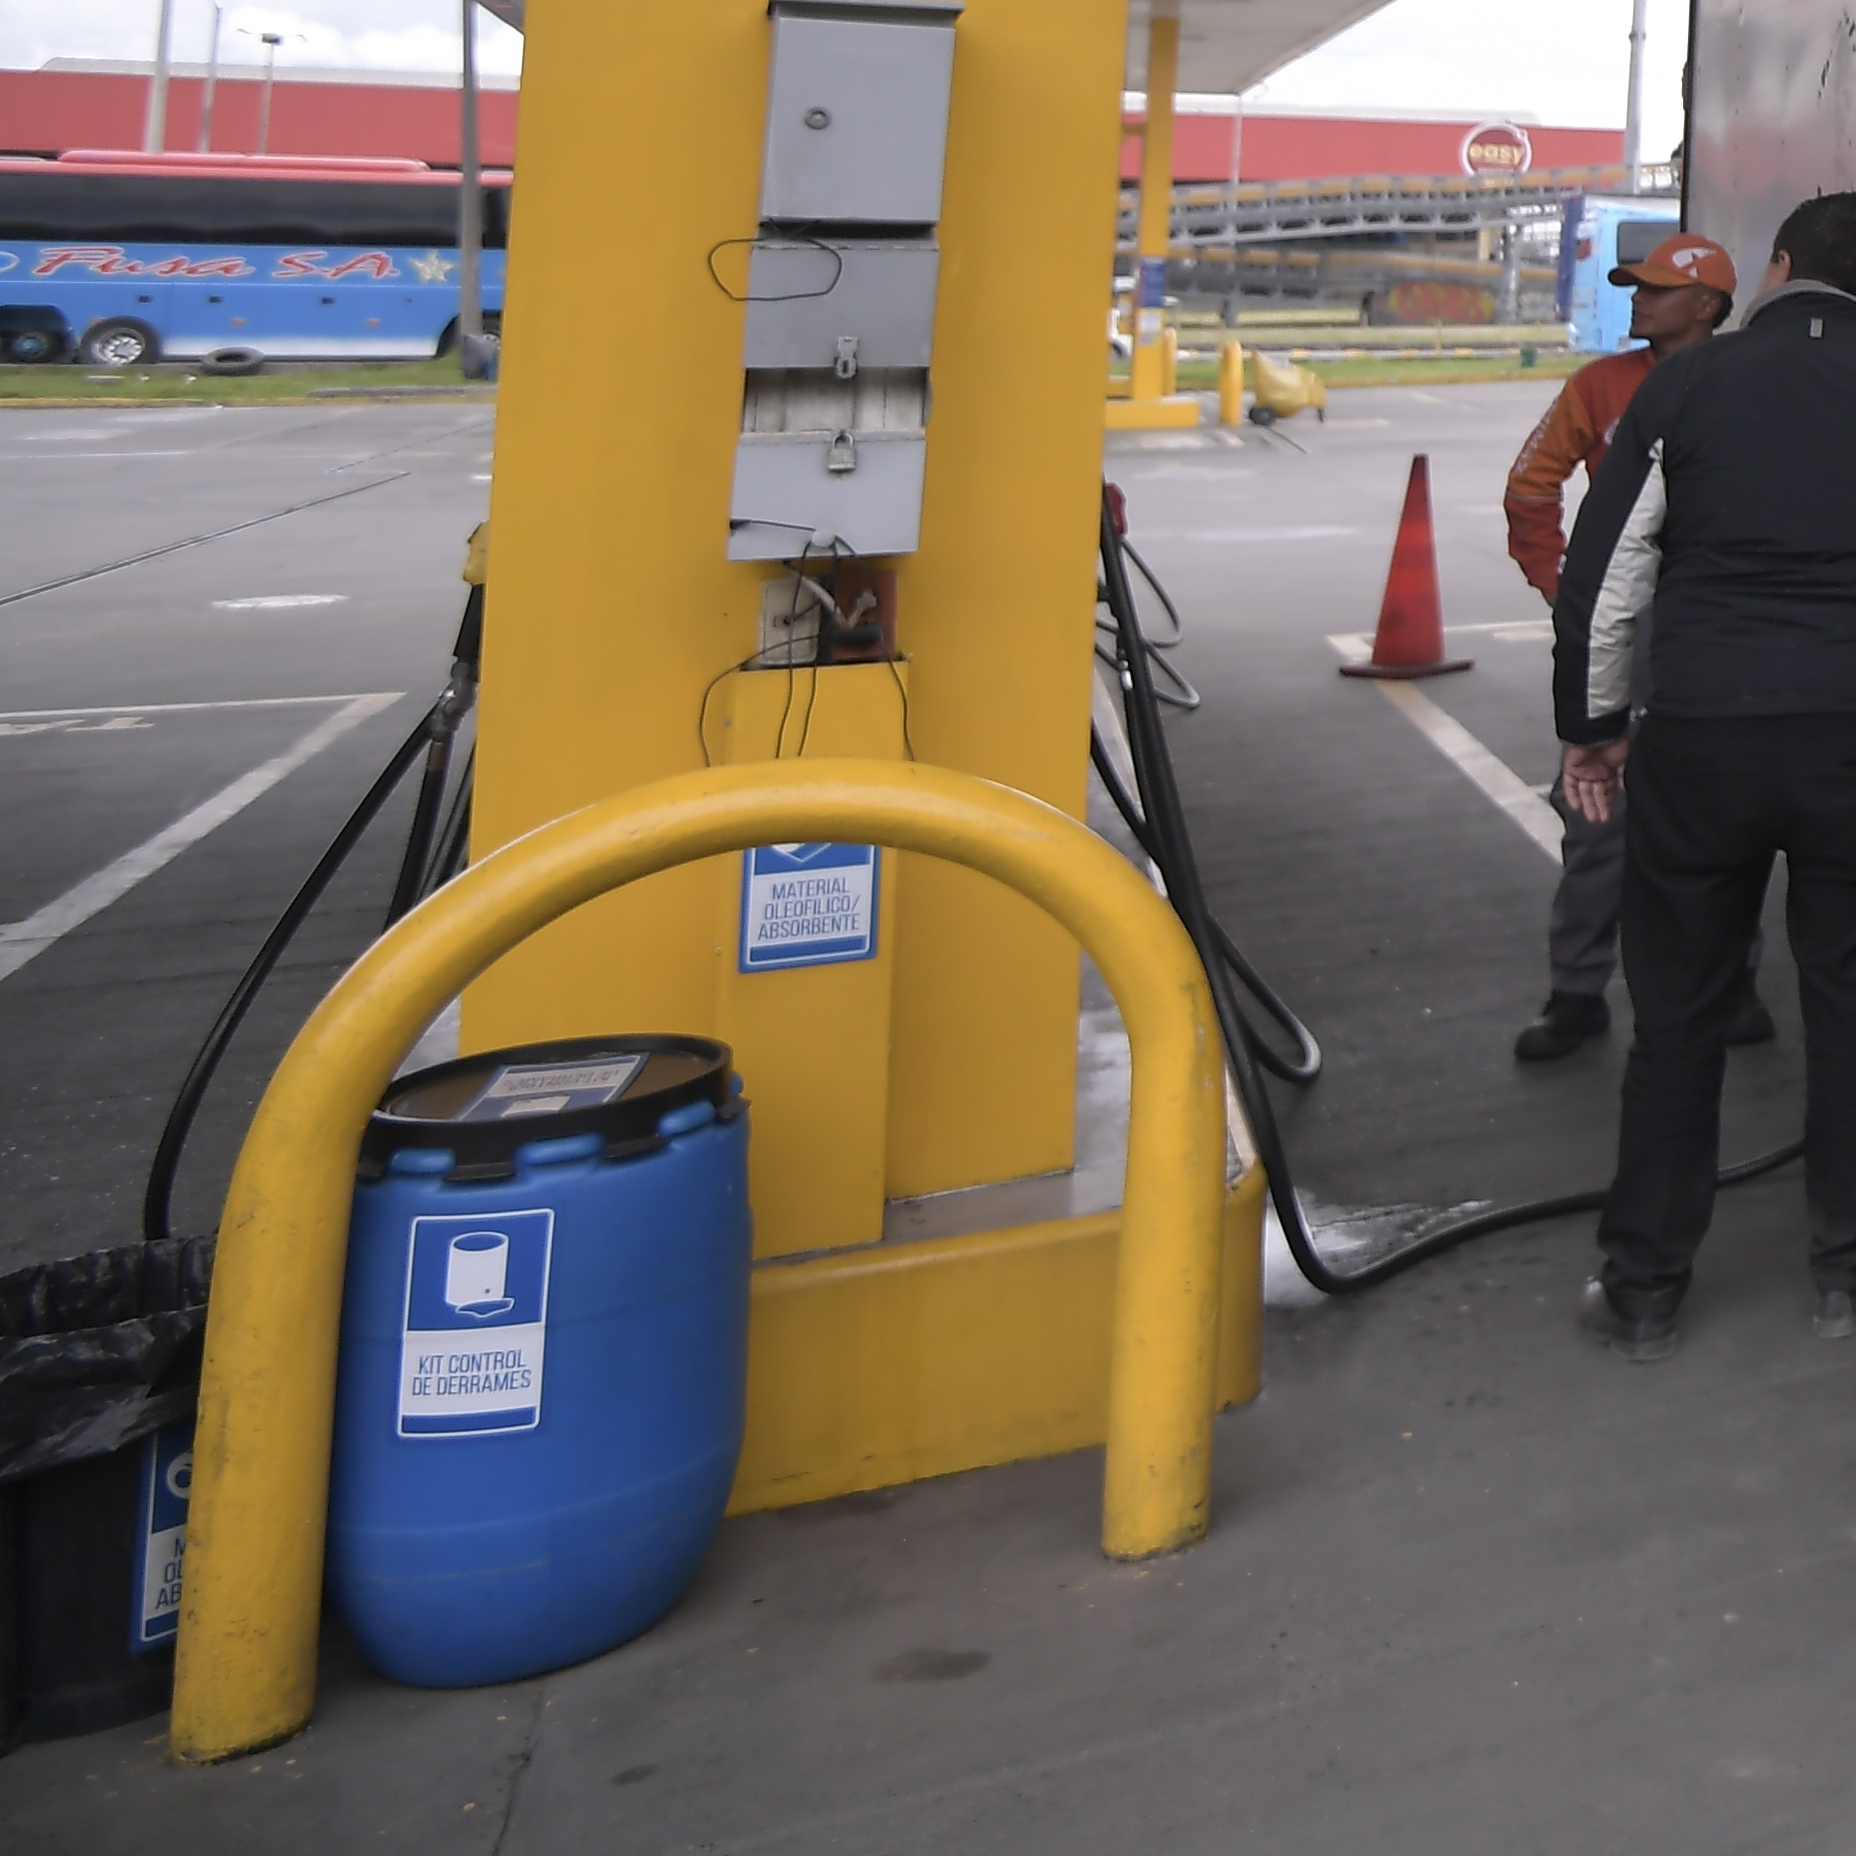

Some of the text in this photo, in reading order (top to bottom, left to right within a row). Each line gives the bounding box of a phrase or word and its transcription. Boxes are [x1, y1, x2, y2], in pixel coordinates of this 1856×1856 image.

[772, 877, 850, 900] MATERIAL
[757, 912, 860, 941] ABSORBENTE
[418, 1349, 527, 1375] KIT CONTROL
[411, 1369, 533, 1397] DE DERRAMES
